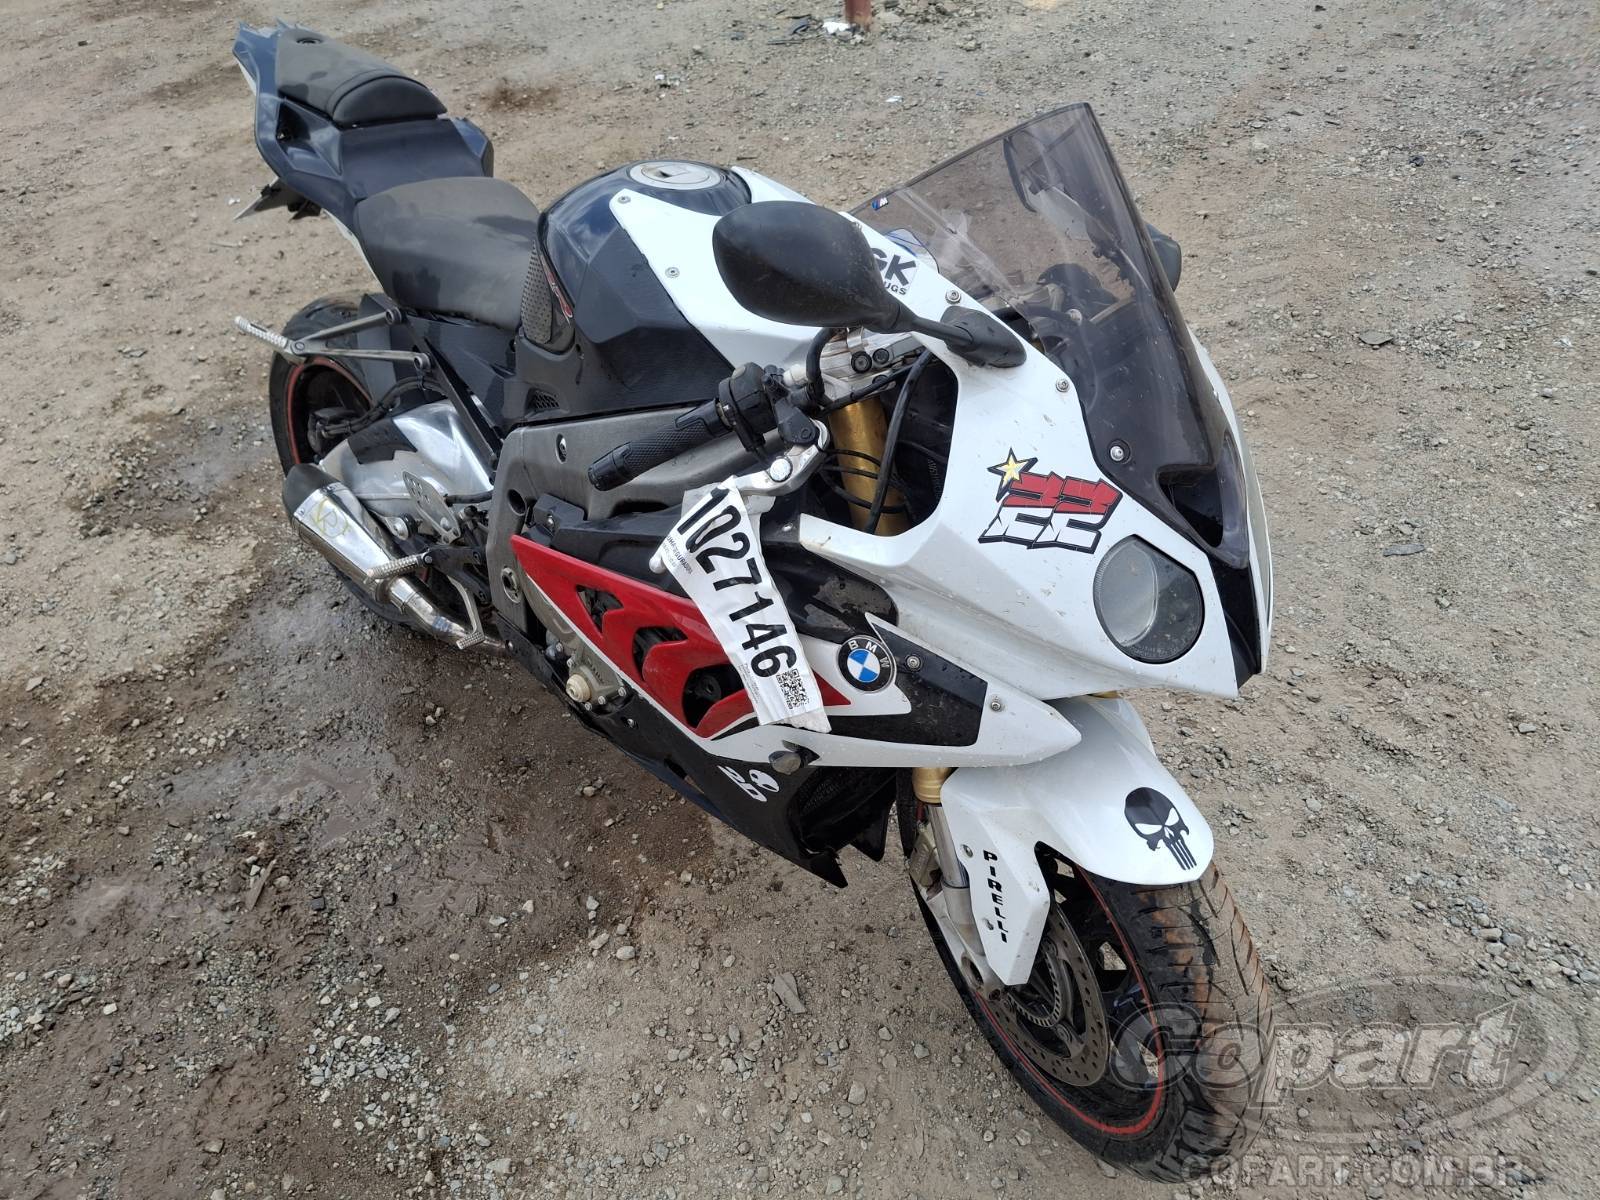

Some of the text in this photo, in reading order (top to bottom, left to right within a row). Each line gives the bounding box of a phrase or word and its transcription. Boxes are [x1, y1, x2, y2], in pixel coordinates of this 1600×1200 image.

[871, 247, 916, 286] GK
[884, 281, 907, 296] UGS
[676, 487, 797, 678] 1027146
[847, 639, 890, 668] BMW
[983, 850, 1009, 943] PIRELLI
